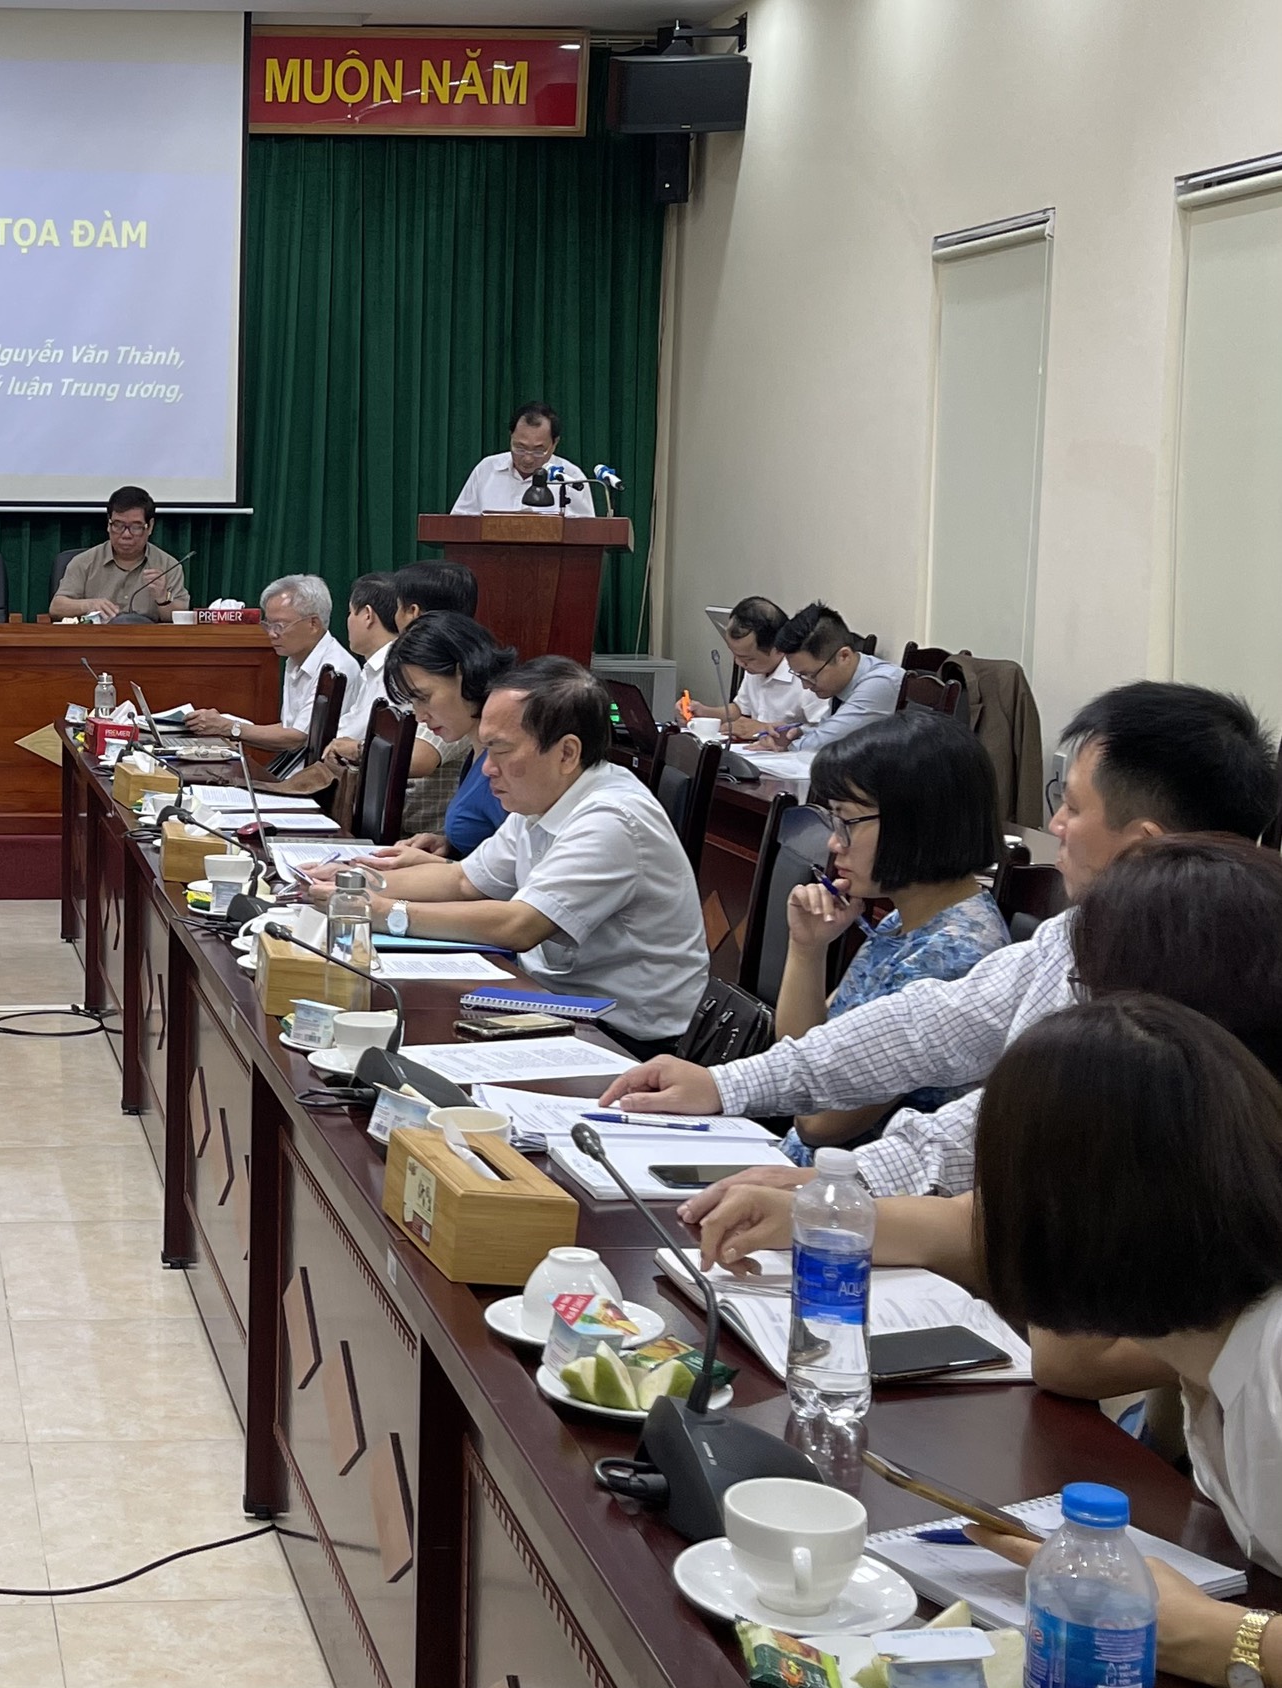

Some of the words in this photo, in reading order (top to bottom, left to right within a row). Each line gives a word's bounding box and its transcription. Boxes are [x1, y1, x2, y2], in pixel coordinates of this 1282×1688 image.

[265, 49, 403, 104] MUÔN
[420, 48, 528, 105] NĂM
[71, 210, 147, 249] ĐÀM
[71, 344, 109, 364] Văn
[7, 376, 52, 400] luận
[61, 378, 121, 402] Trung
[125, 380, 185, 403] ương,
[198, 610, 243, 622] PREMIER
